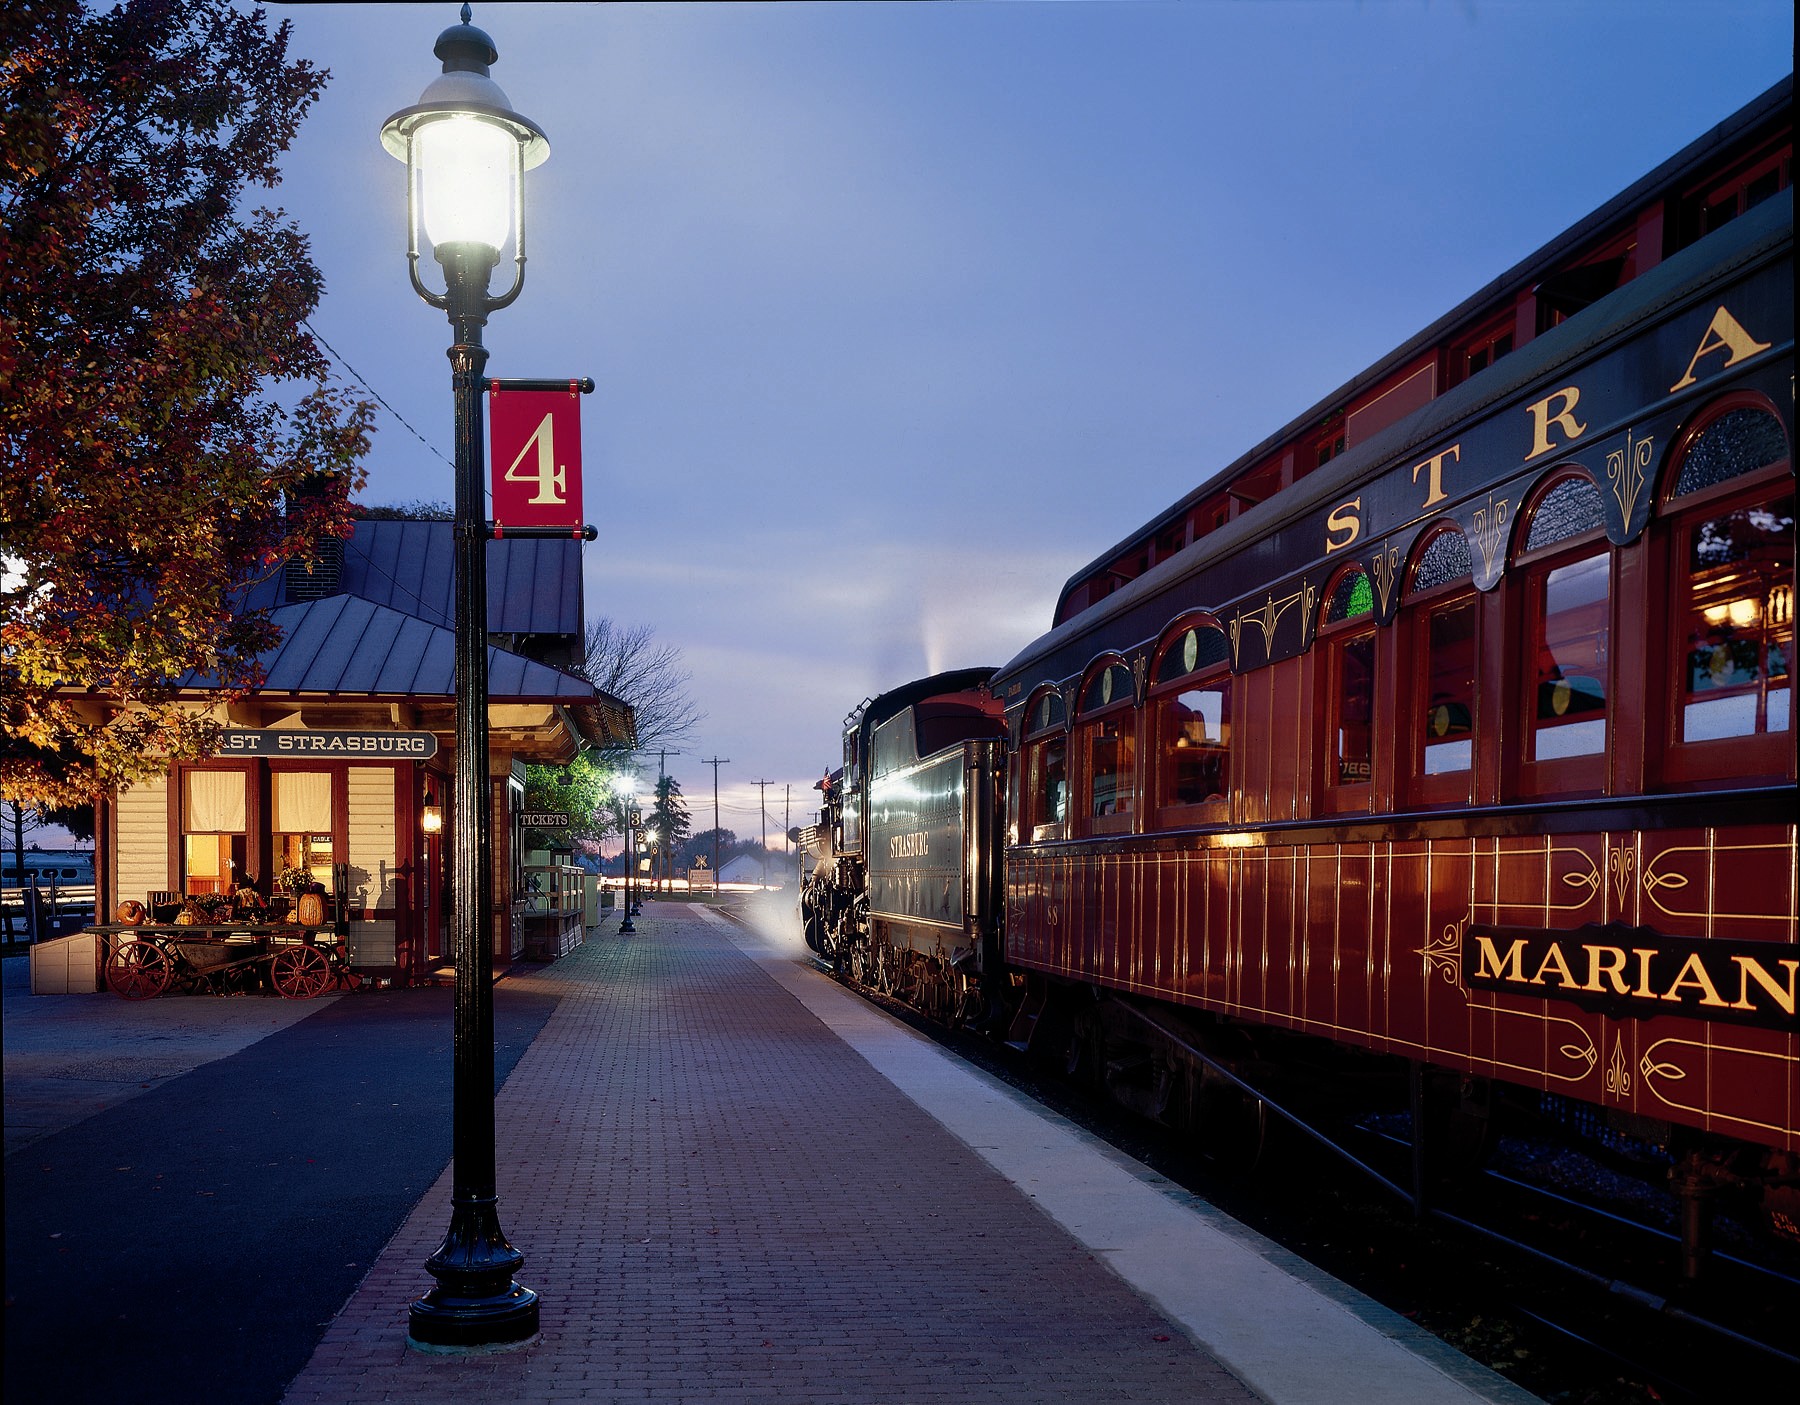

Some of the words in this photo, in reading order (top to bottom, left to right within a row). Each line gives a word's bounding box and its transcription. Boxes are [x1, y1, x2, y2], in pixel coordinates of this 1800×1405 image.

[504, 412, 566, 504] 4
[278, 735, 425, 752] STRASBURG
[520, 814, 568, 826] TICKETS
[631, 812, 640, 826] 3
[637, 832, 644, 842] 2
[1047, 905, 1058, 926] 88
[1474, 936, 1799, 1014] MARIAN
